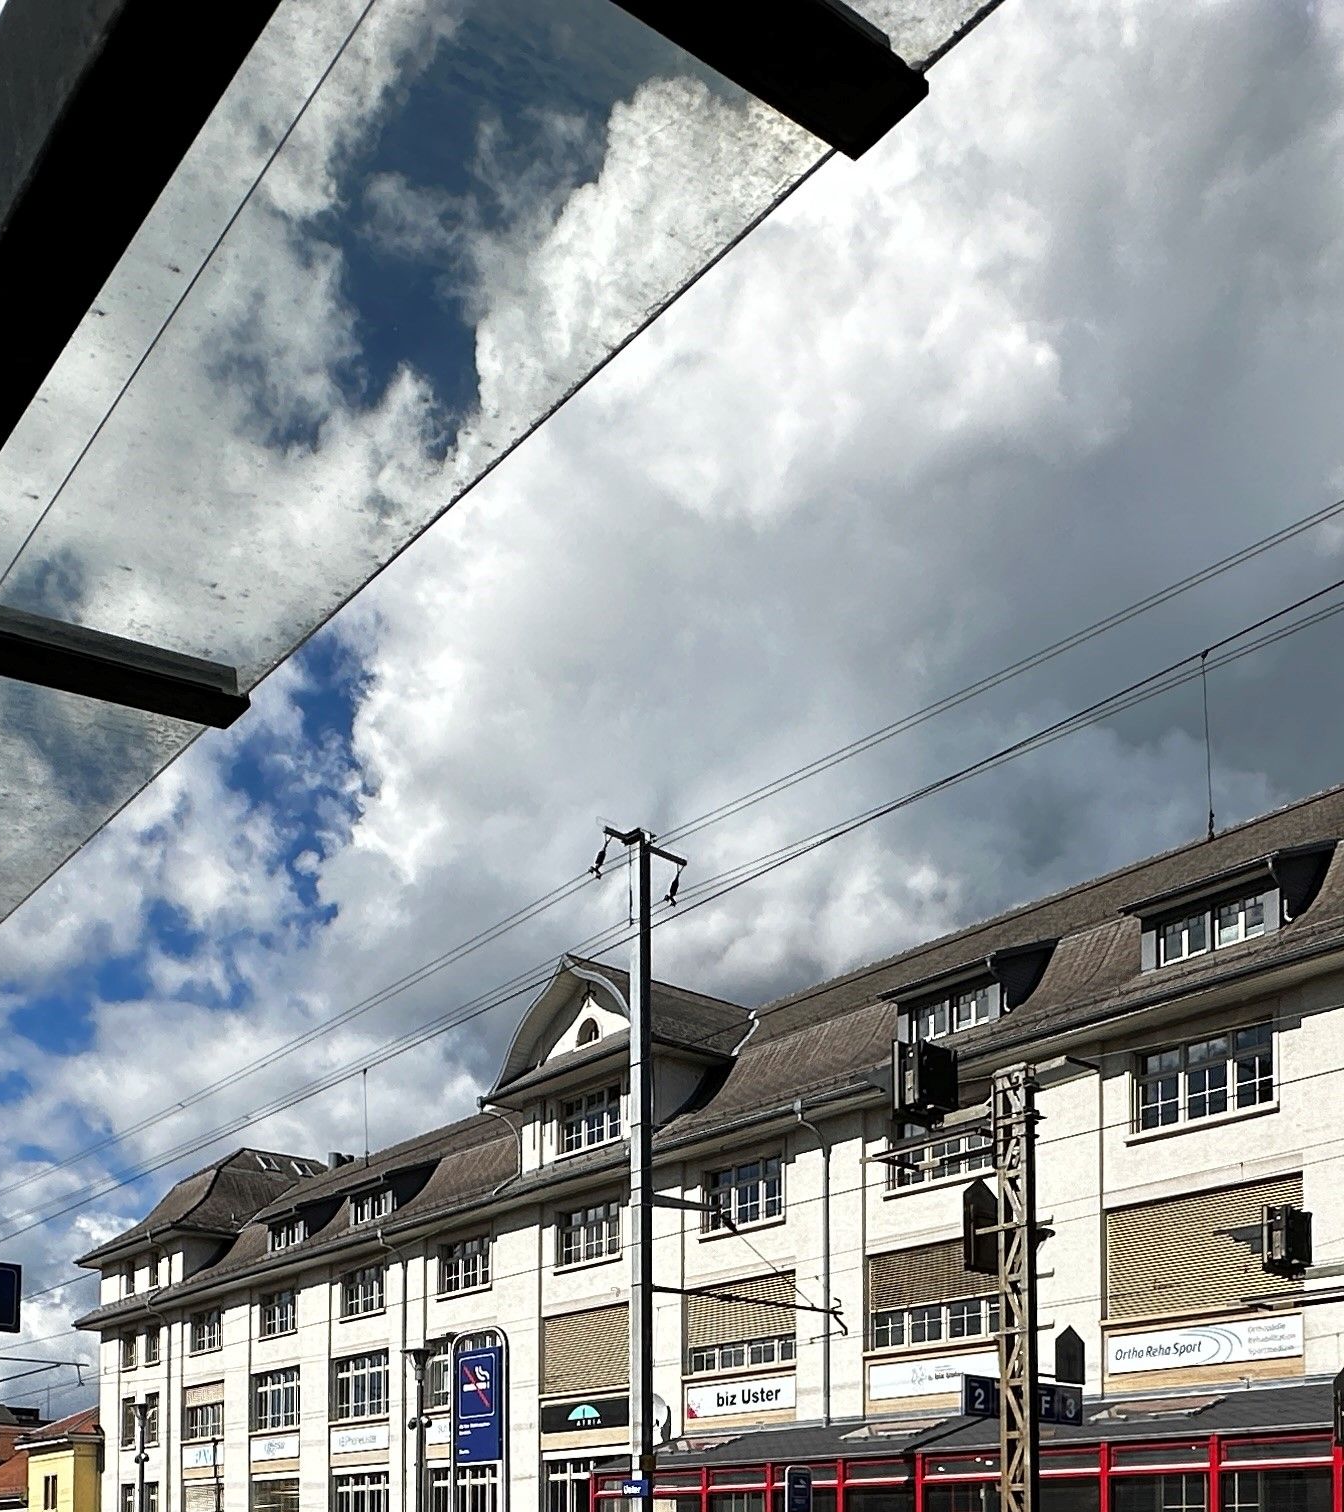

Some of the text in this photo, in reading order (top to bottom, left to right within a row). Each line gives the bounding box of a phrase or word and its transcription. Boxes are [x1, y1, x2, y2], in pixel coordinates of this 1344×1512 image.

[1115, 1341, 1202, 1361] Ortho Reha Sport
[716, 1387, 781, 1408] biz Uster
[974, 1387, 985, 1410] 2
[1041, 1395, 1052, 1416] F
[1065, 1398, 1076, 1419] 3
